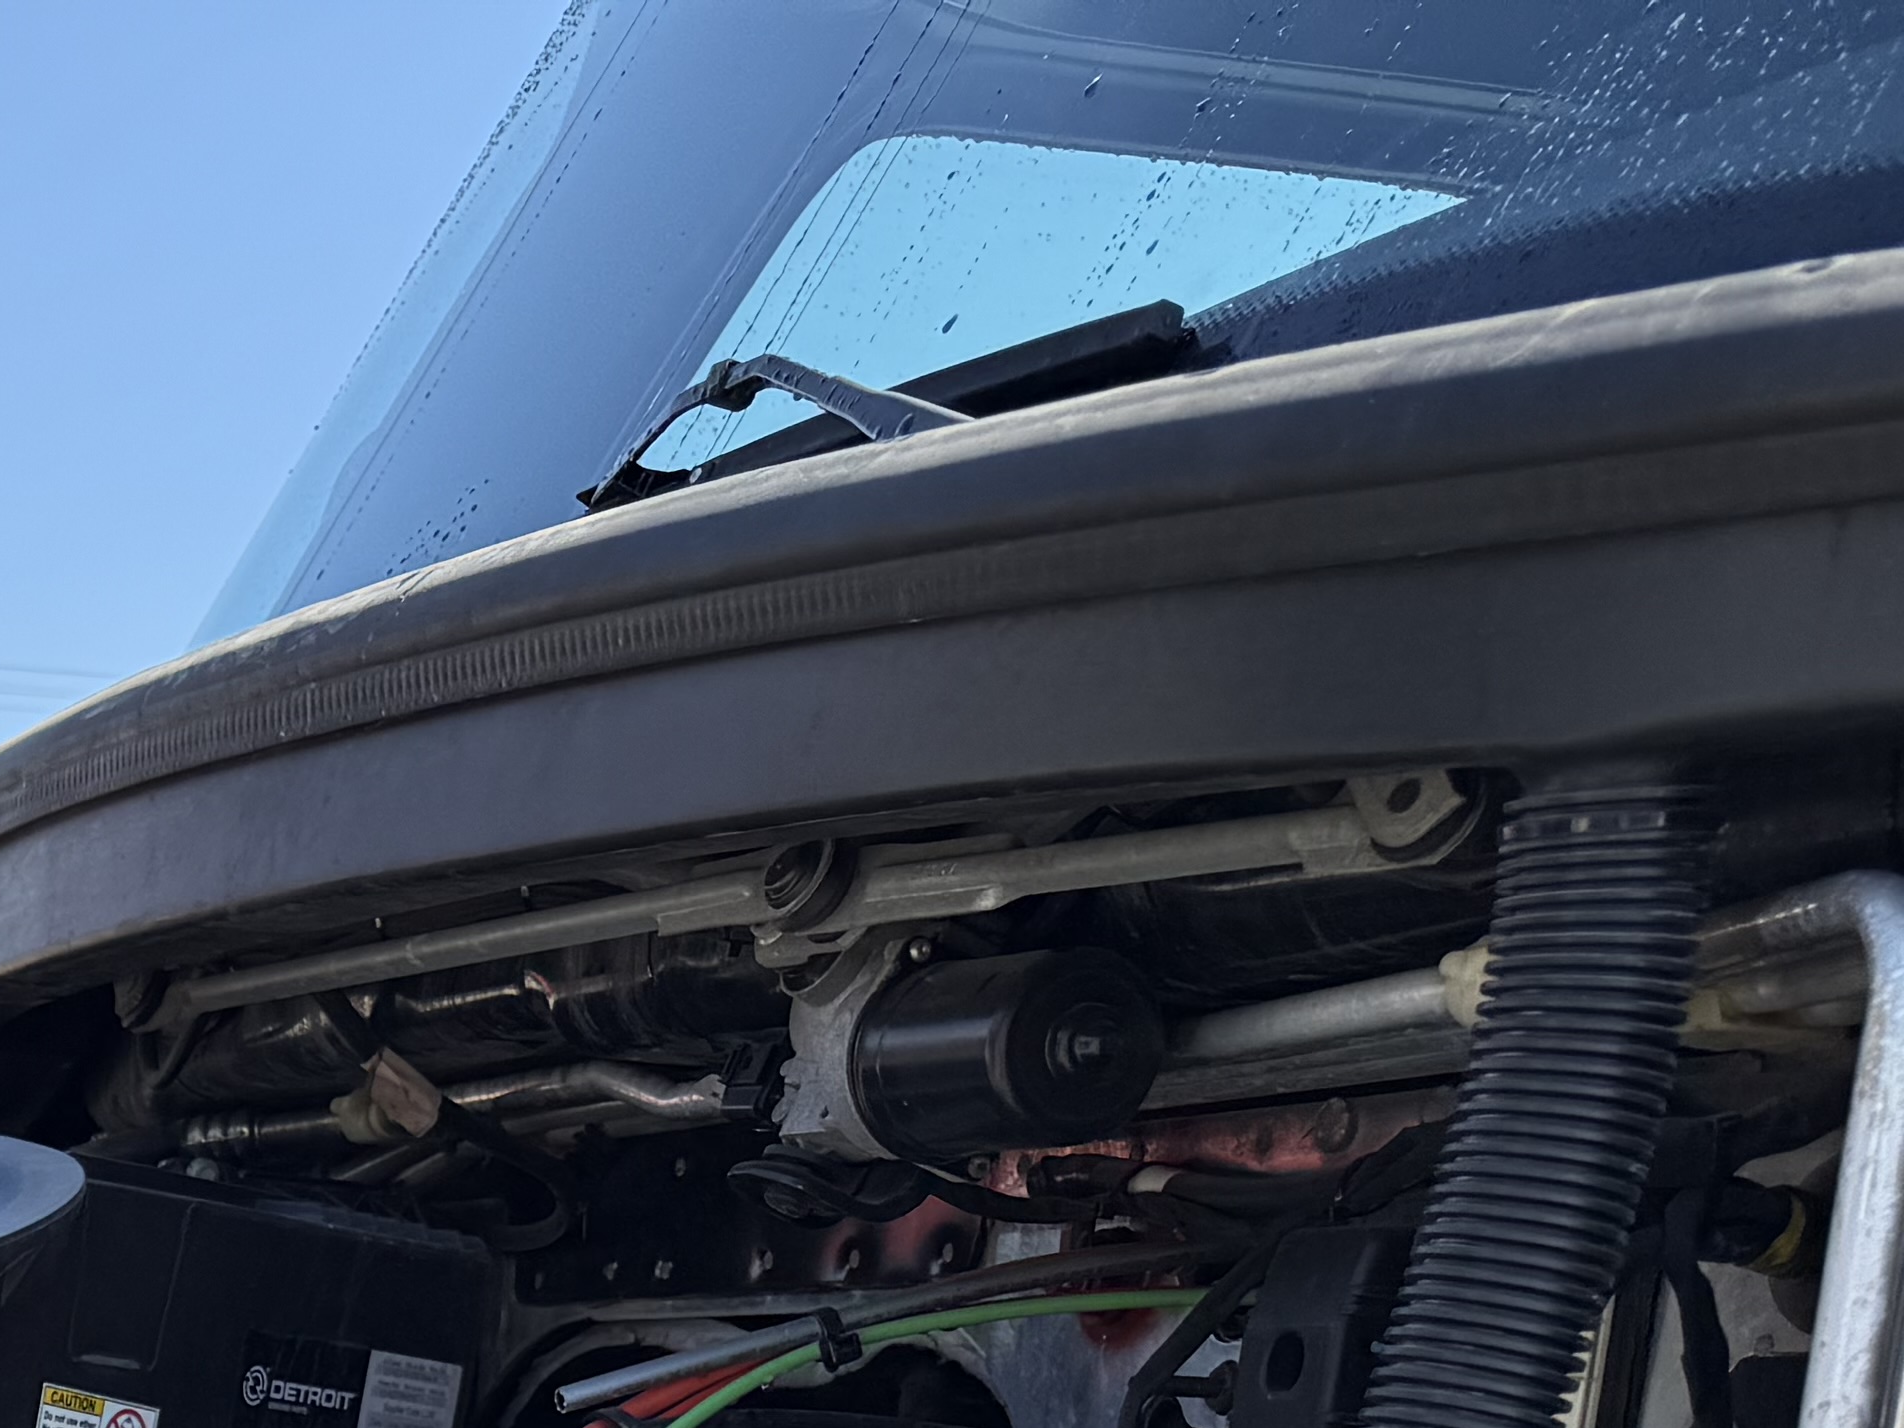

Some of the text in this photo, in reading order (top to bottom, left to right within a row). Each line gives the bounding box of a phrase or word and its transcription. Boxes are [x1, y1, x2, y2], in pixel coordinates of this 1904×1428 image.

[51, 1391, 96, 1412] CAUTION
[270, 1380, 358, 1410] DETROIT
[44, 1411, 53, 1421] Do
[54, 1414, 66, 1423] not
